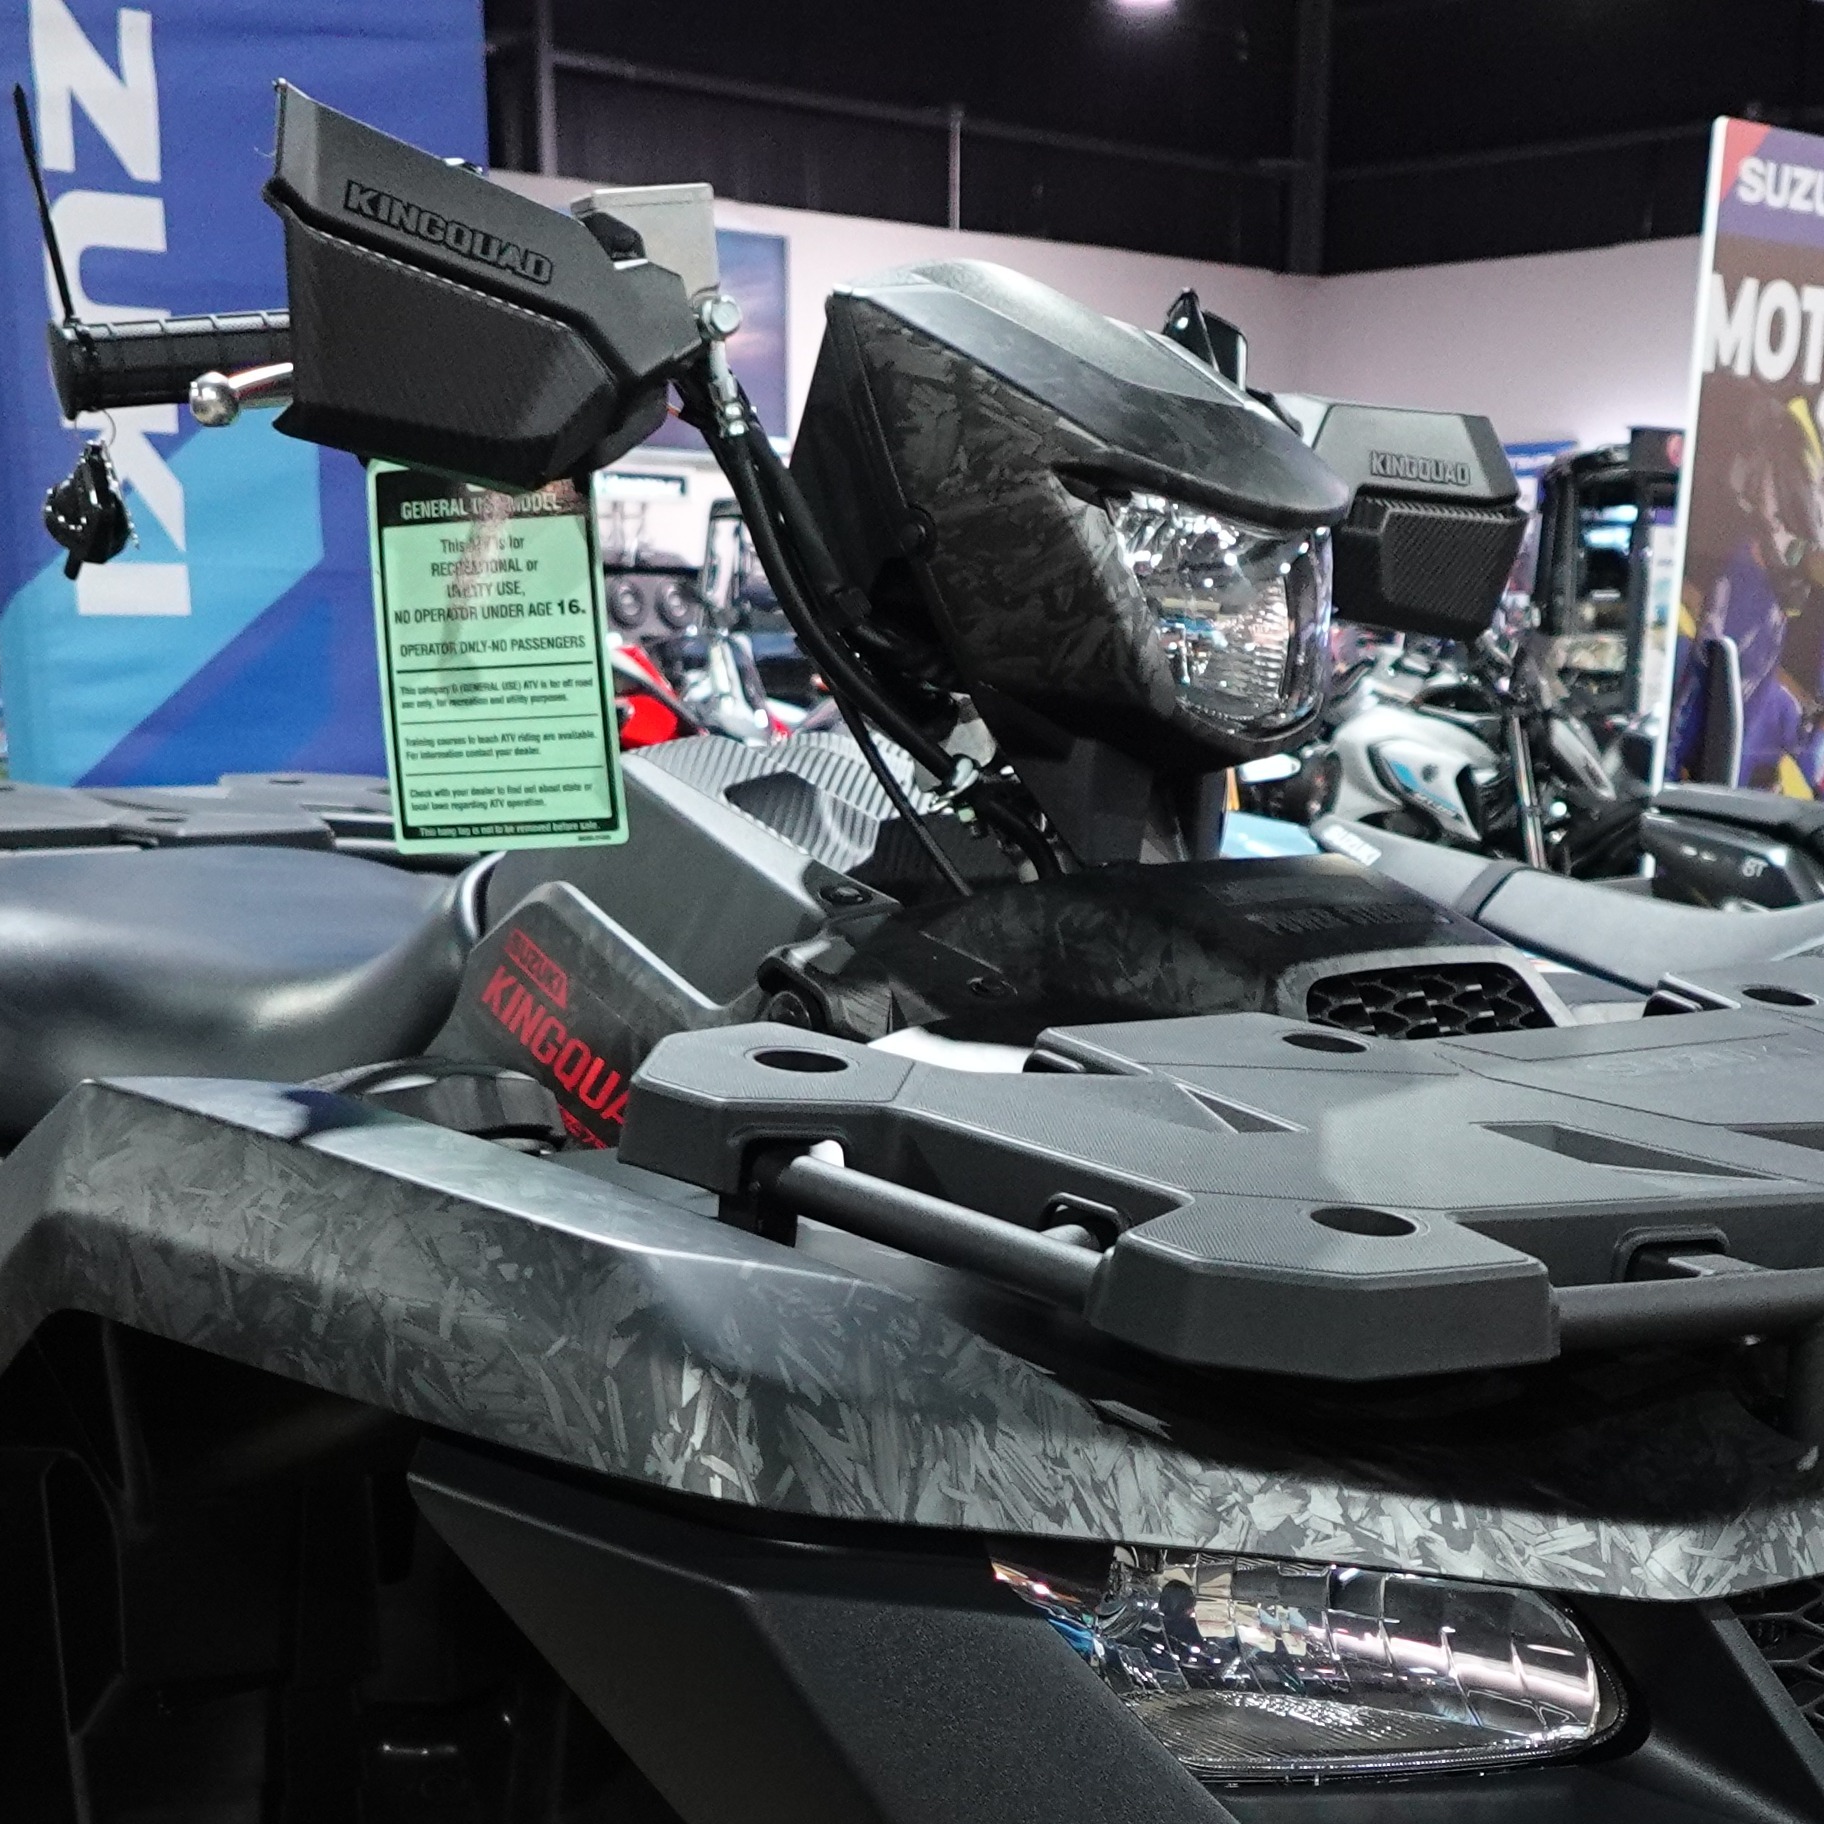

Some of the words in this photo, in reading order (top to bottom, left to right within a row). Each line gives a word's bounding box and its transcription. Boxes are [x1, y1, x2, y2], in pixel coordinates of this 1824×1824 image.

[345, 181, 553, 285] KINGQUAD
[28, 0, 191, 615] ZUKI
[1370, 450, 1471, 486] KINGQUAD
[400, 501, 468, 520] GENERAL
[440, 539, 465, 553] This
[394, 609, 410, 624] NO
[414, 606, 476, 623] OPERATOR
[481, 603, 525, 620] UNDER
[528, 601, 552, 616] AGE
[557, 599, 586, 616] 16.
[400, 643, 456, 657] OPERATOR
[510, 635, 586, 652] PASSENGERS
[481, 965, 631, 1124] KINGQUA
